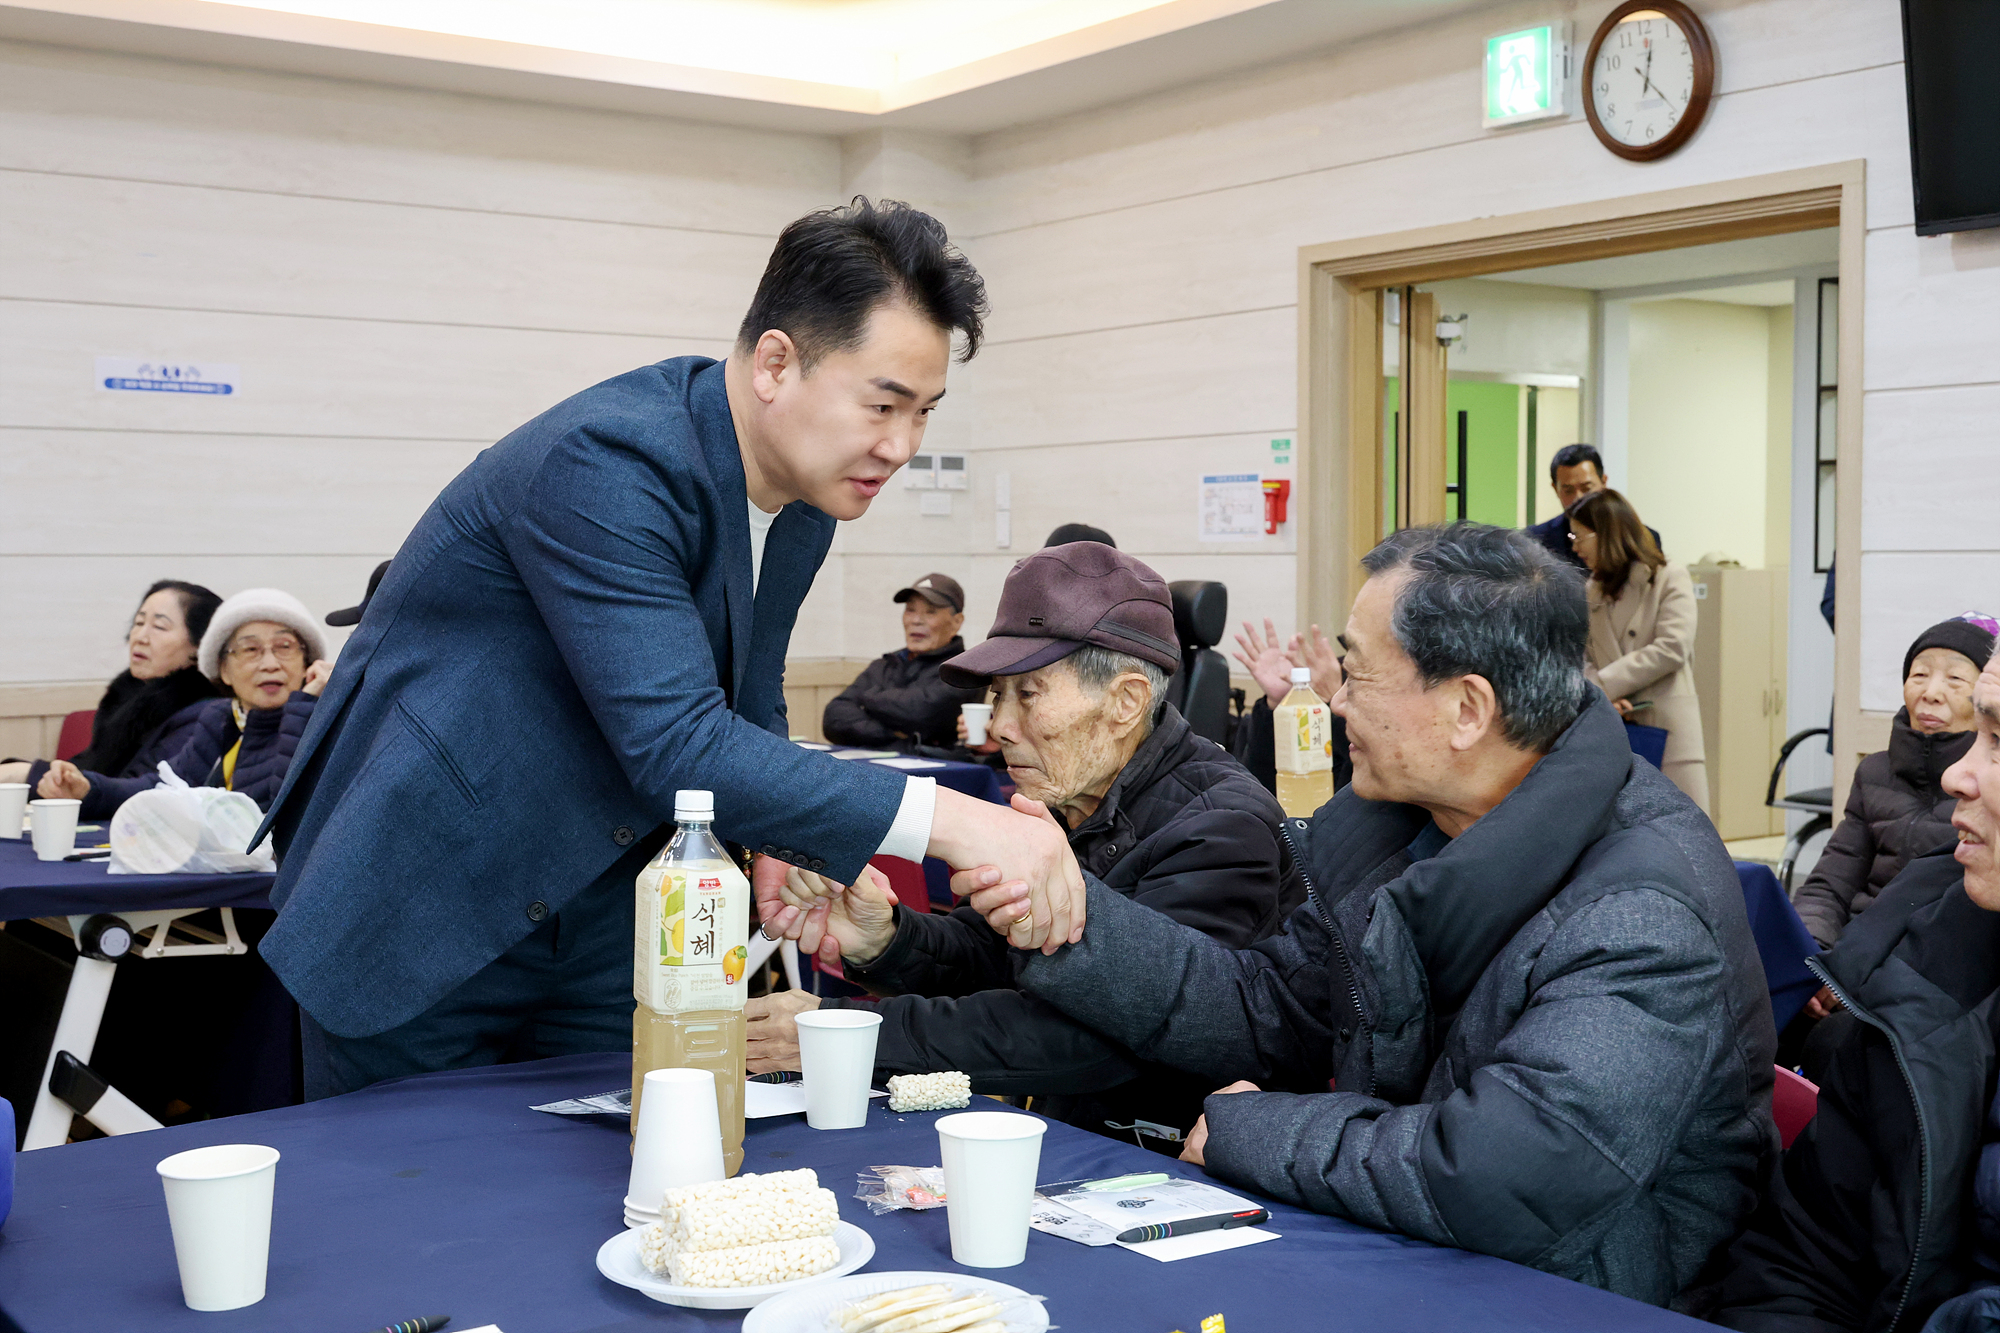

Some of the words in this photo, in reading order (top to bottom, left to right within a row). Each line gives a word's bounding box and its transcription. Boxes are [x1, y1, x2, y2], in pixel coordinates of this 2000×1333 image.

[1638, 20, 1651, 36] 12
[1665, 23, 1670, 38] 1
[1620, 32, 1632, 48] 11
[1606, 55, 1621, 71] 10
[1600, 82, 1609, 97] 9
[1681, 88, 1688, 103] 4
[1607, 103, 1616, 118] 8
[1625, 120, 1633, 136] 7
[1668, 112, 1676, 128] 5
[1645, 124, 1654, 138] 6
[690, 898, 716, 959] 식혜
